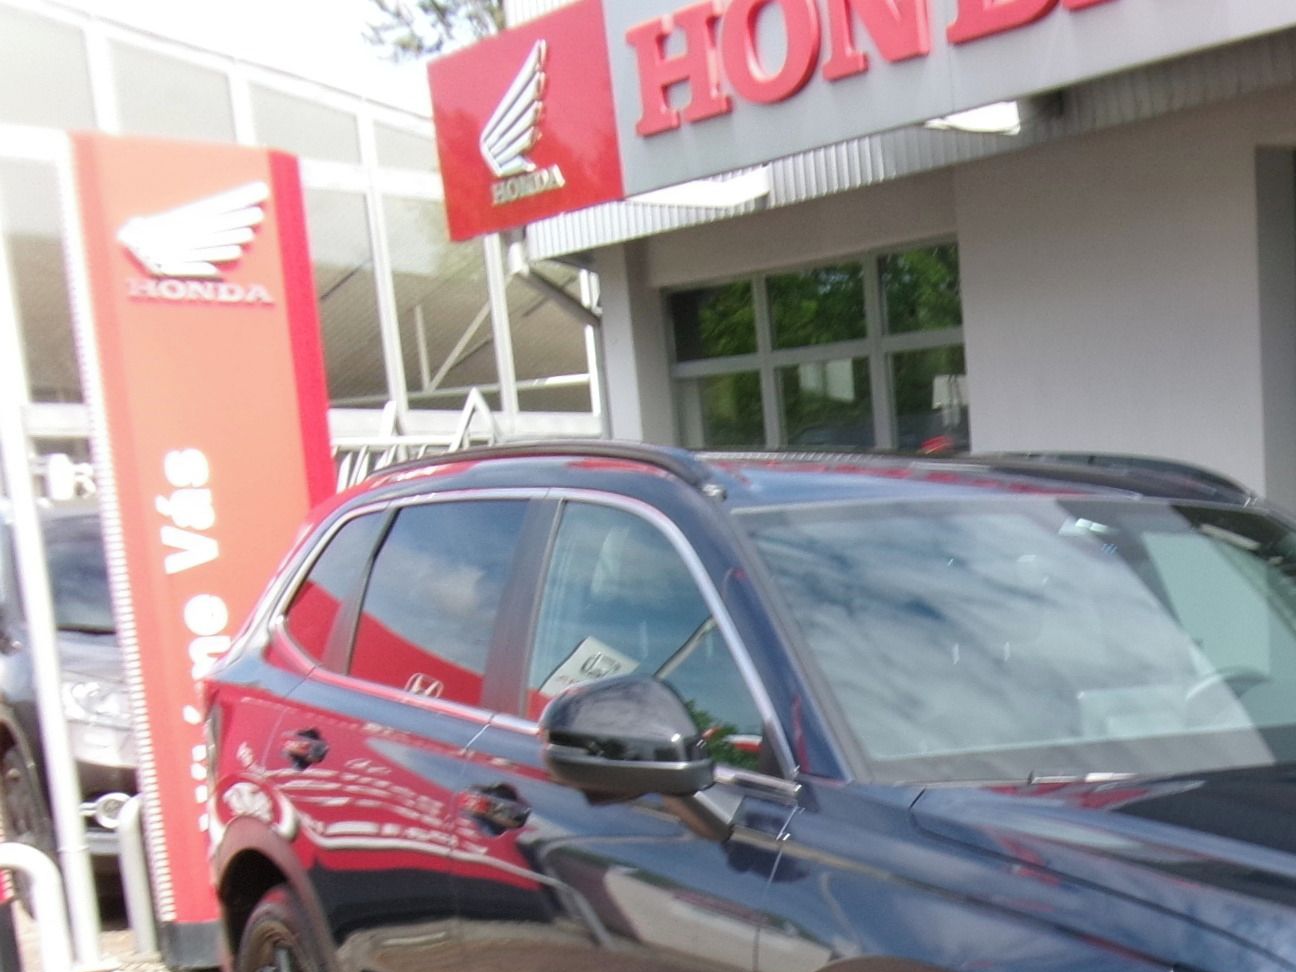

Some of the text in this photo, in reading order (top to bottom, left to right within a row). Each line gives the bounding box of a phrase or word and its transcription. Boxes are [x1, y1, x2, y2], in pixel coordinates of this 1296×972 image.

[625, 0, 1114, 137] HON
[491, 164, 566, 207] HONDA
[127, 278, 273, 304] HONDA
[154, 447, 220, 576] Vás
